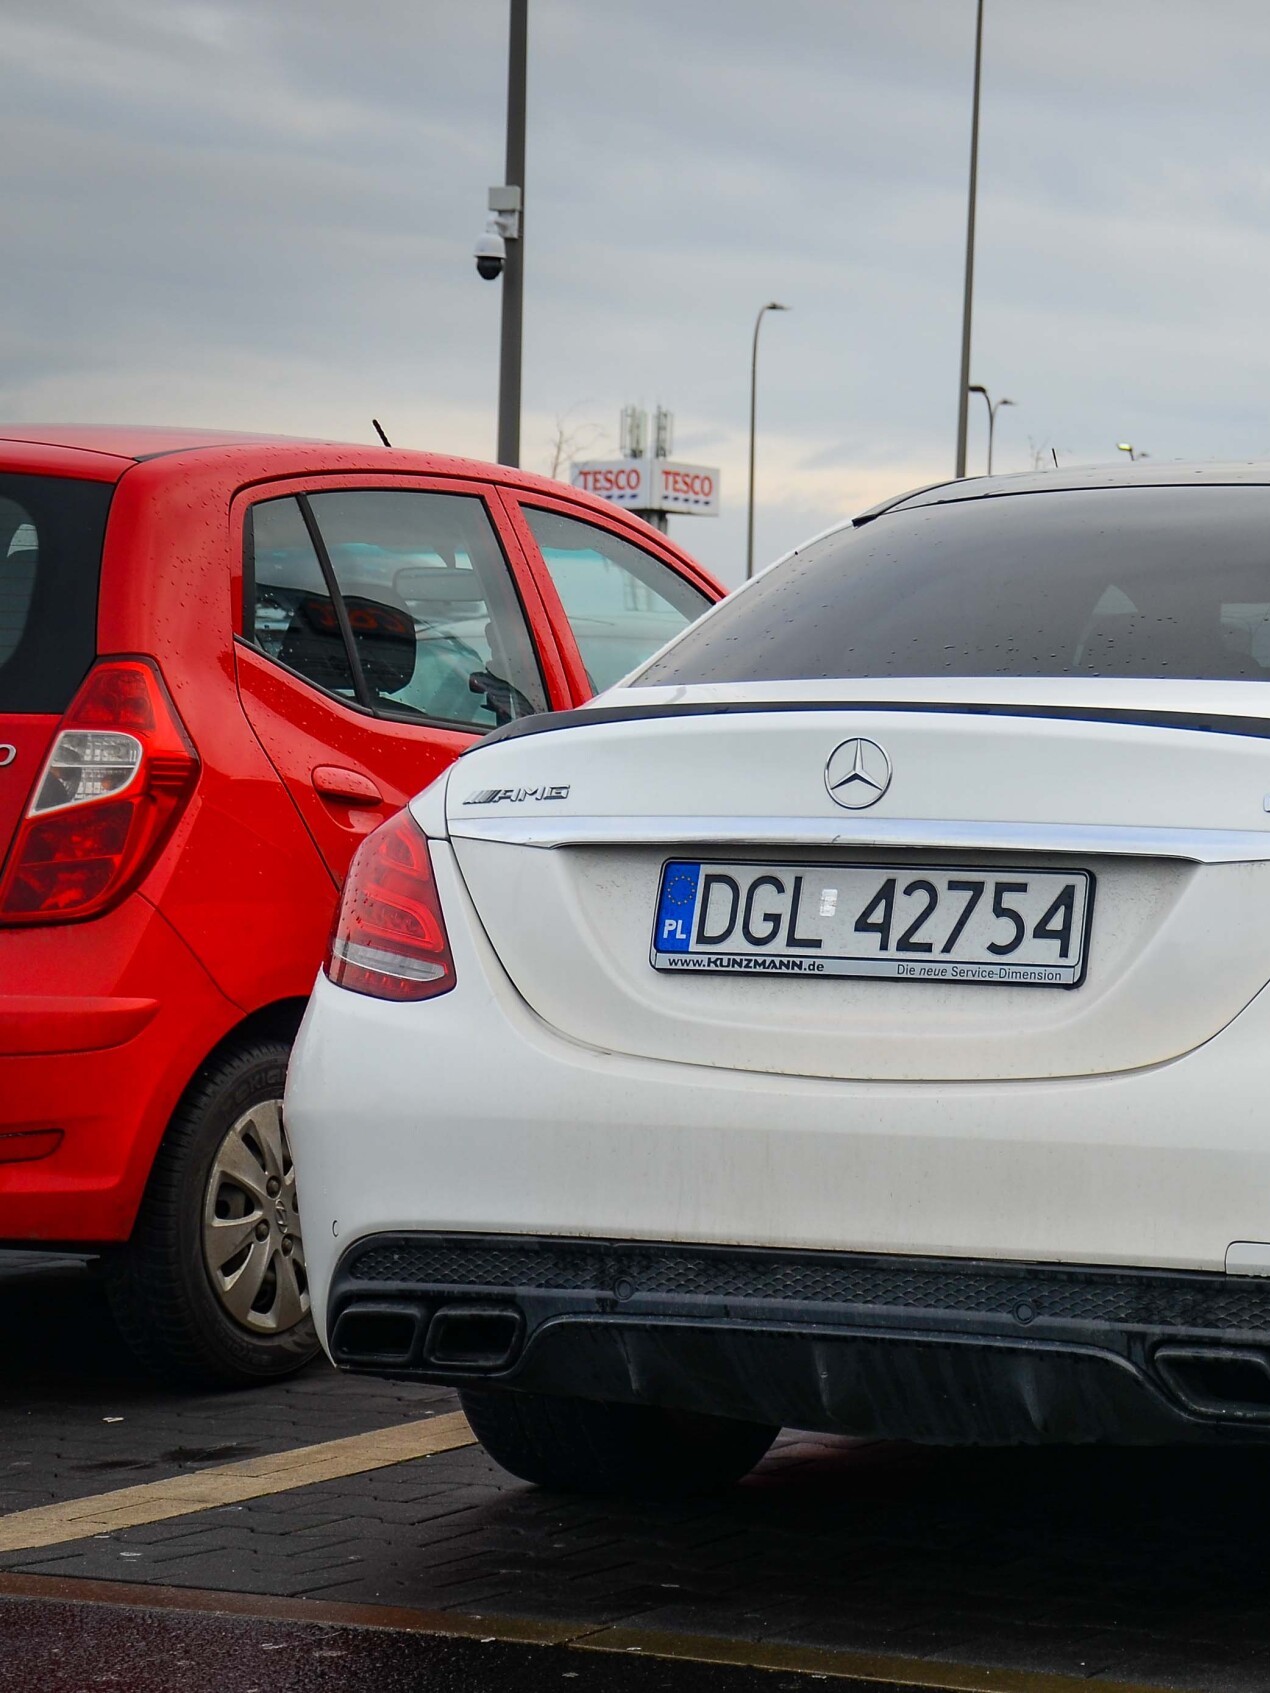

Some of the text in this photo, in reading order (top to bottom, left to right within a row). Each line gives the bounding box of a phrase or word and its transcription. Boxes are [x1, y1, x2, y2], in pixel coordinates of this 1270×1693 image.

[579, 469, 641, 491] TESCO
[662, 470, 713, 496] TESCO
[695, 873, 1077, 959] DGL 42754
[663, 919, 687, 940] PL
[668, 956, 825, 972] www.KUNZMANN.de
[897, 964, 1062, 982] Die neue Service-Dimension
